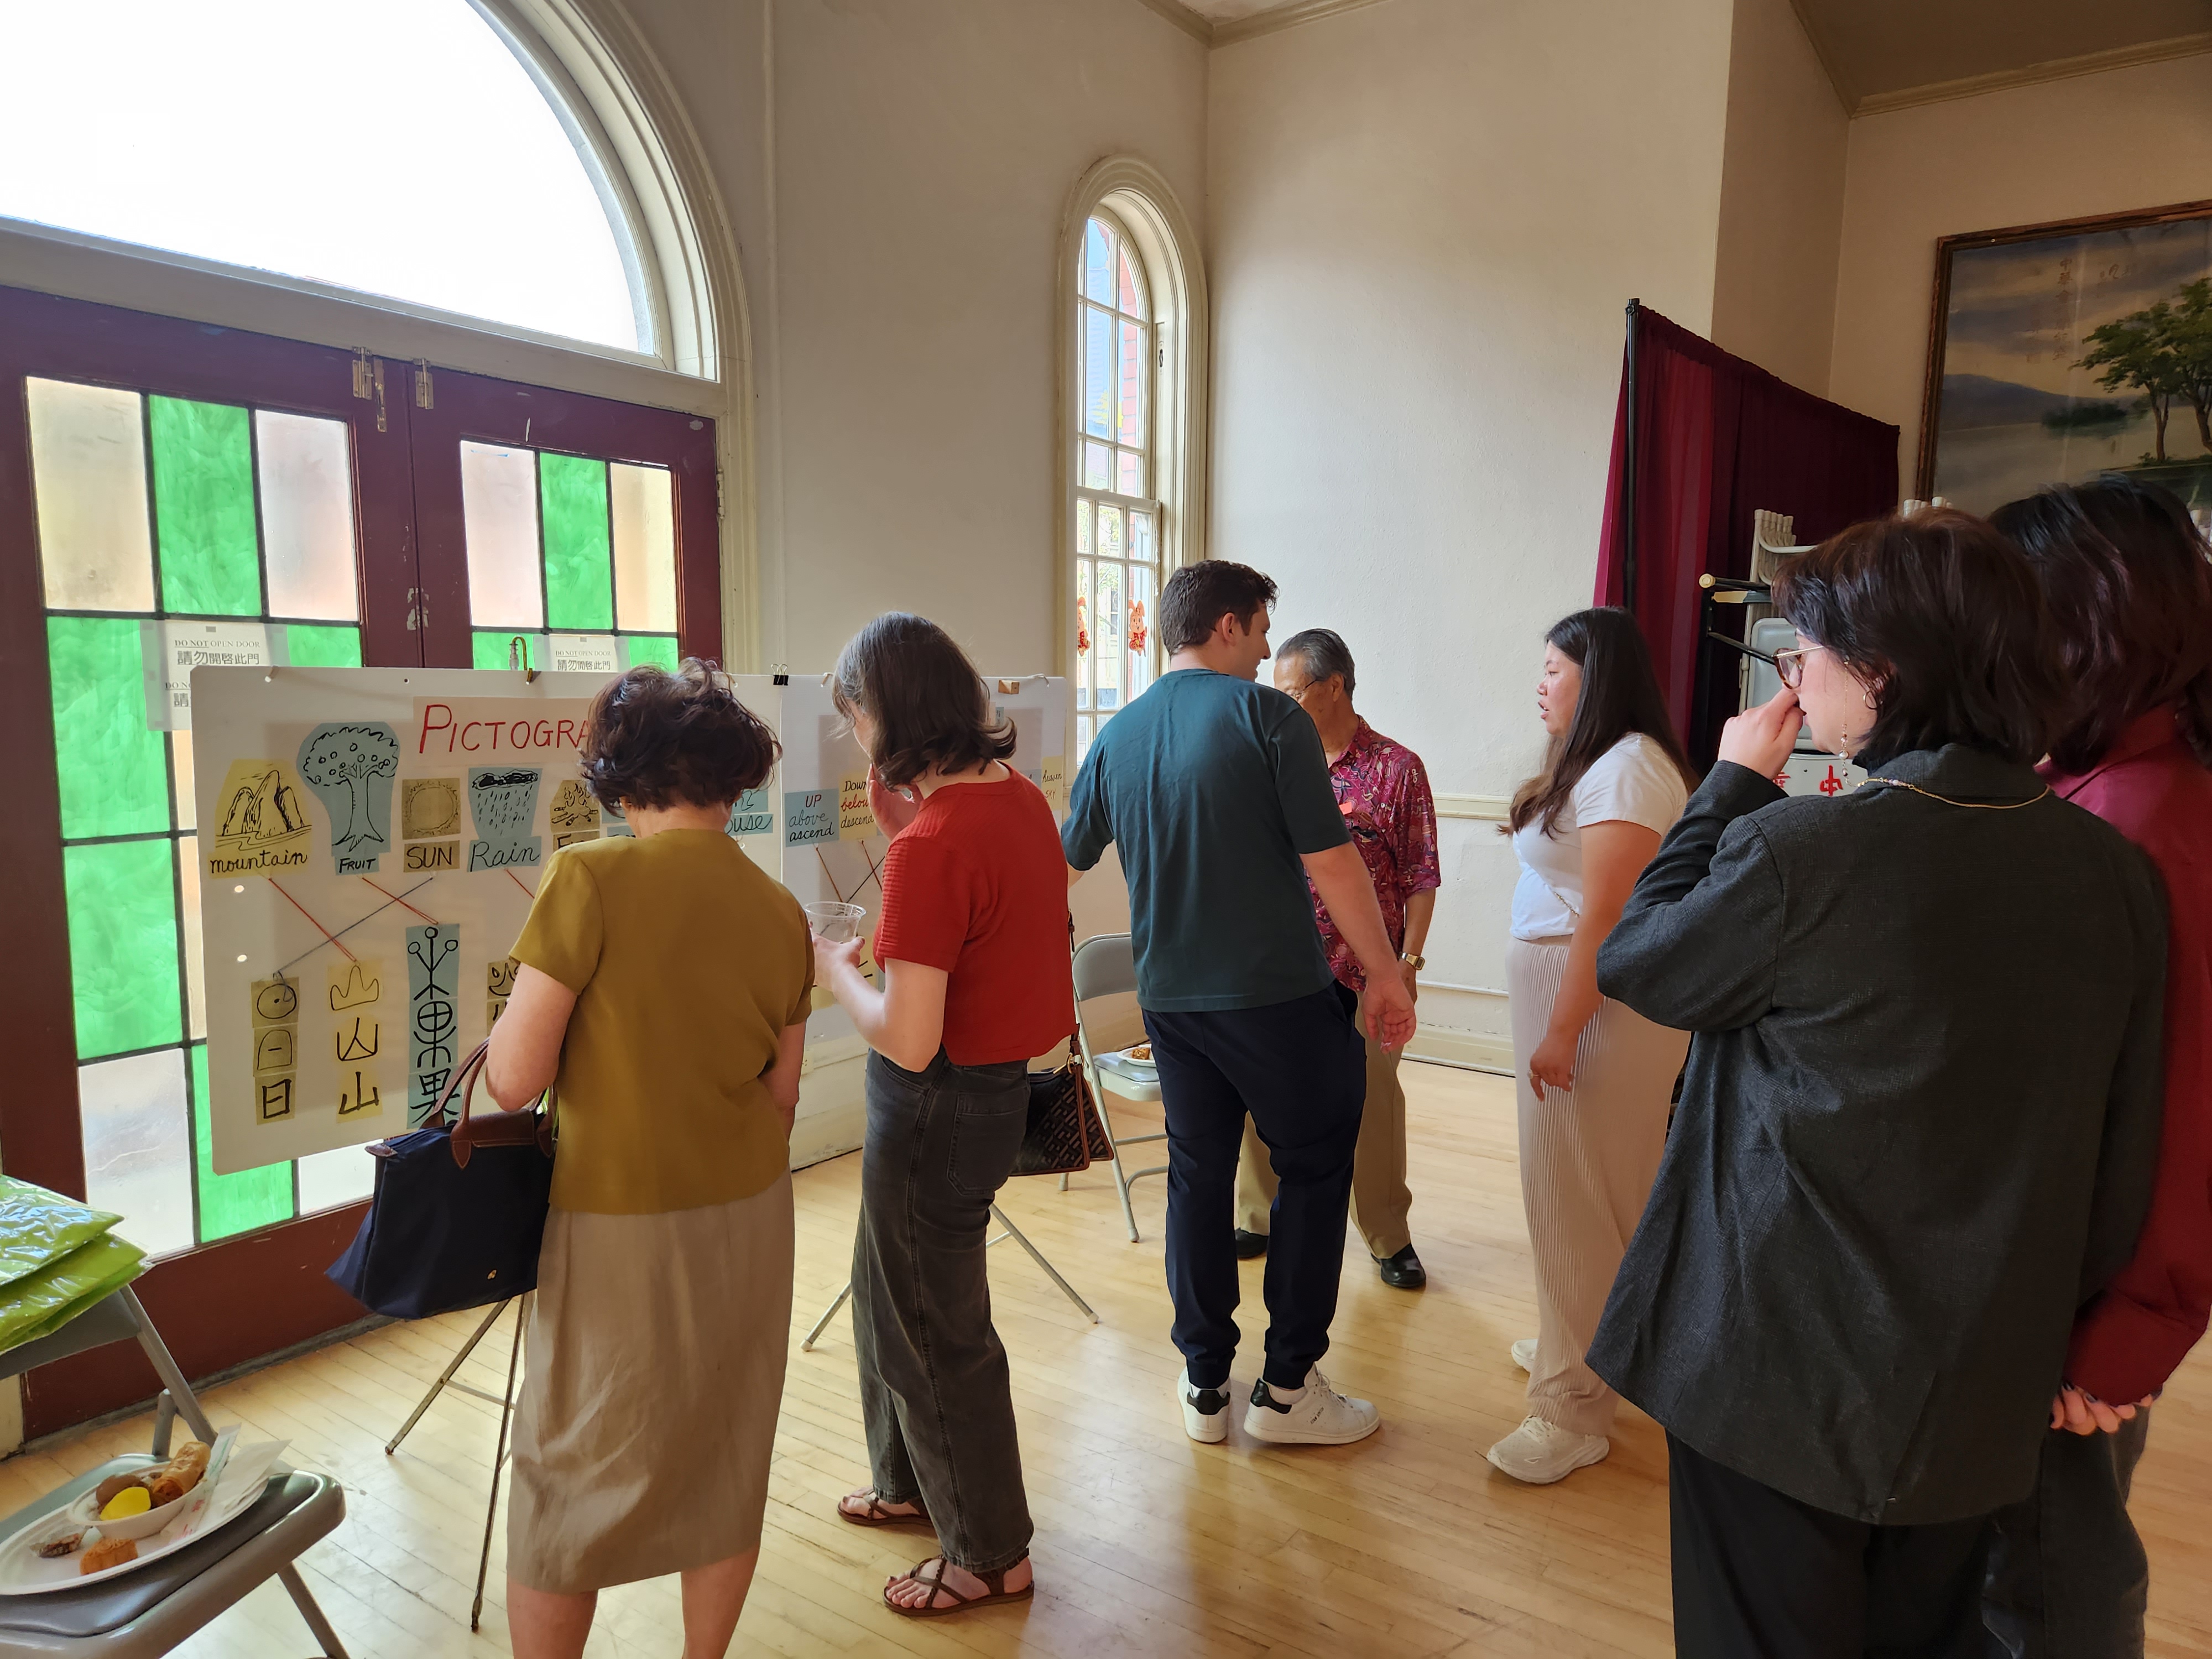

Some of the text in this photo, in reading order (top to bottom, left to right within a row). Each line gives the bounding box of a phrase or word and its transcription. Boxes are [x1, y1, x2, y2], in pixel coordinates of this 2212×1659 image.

[419, 704, 589, 754] PICTOGRA
[1042, 769, 1062, 783] heaven
[805, 794, 822, 808] UP
[789, 809, 829, 827] above
[841, 814, 875, 828] descend
[790, 822, 834, 842] ascend
[210, 850, 308, 874] mountain
[338, 857, 377, 874] FRUIT
[406, 846, 452, 870] SUN
[469, 845, 541, 873] Rain
[262, 1079, 292, 1119] 日
[338, 1071, 379, 1115] 山
